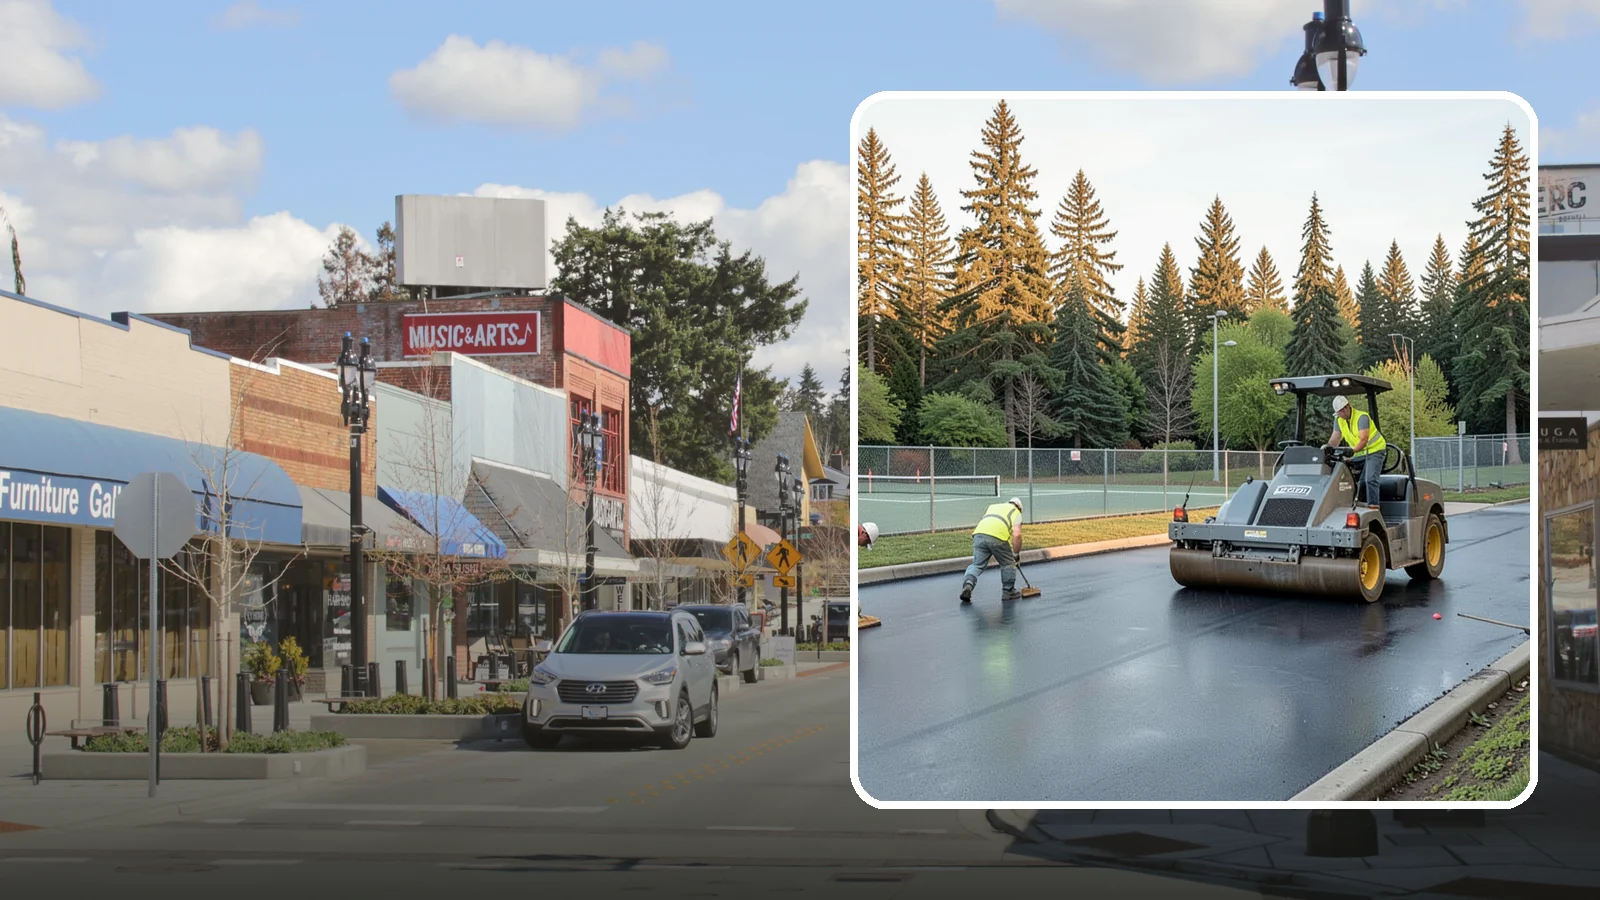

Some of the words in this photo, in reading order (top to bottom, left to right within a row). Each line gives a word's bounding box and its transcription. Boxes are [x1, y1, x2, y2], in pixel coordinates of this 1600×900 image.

[409, 323, 520, 348] MUSIC&ARTS
[0, 471, 79, 515] Furniture
[89, 482, 121, 518] Gal
